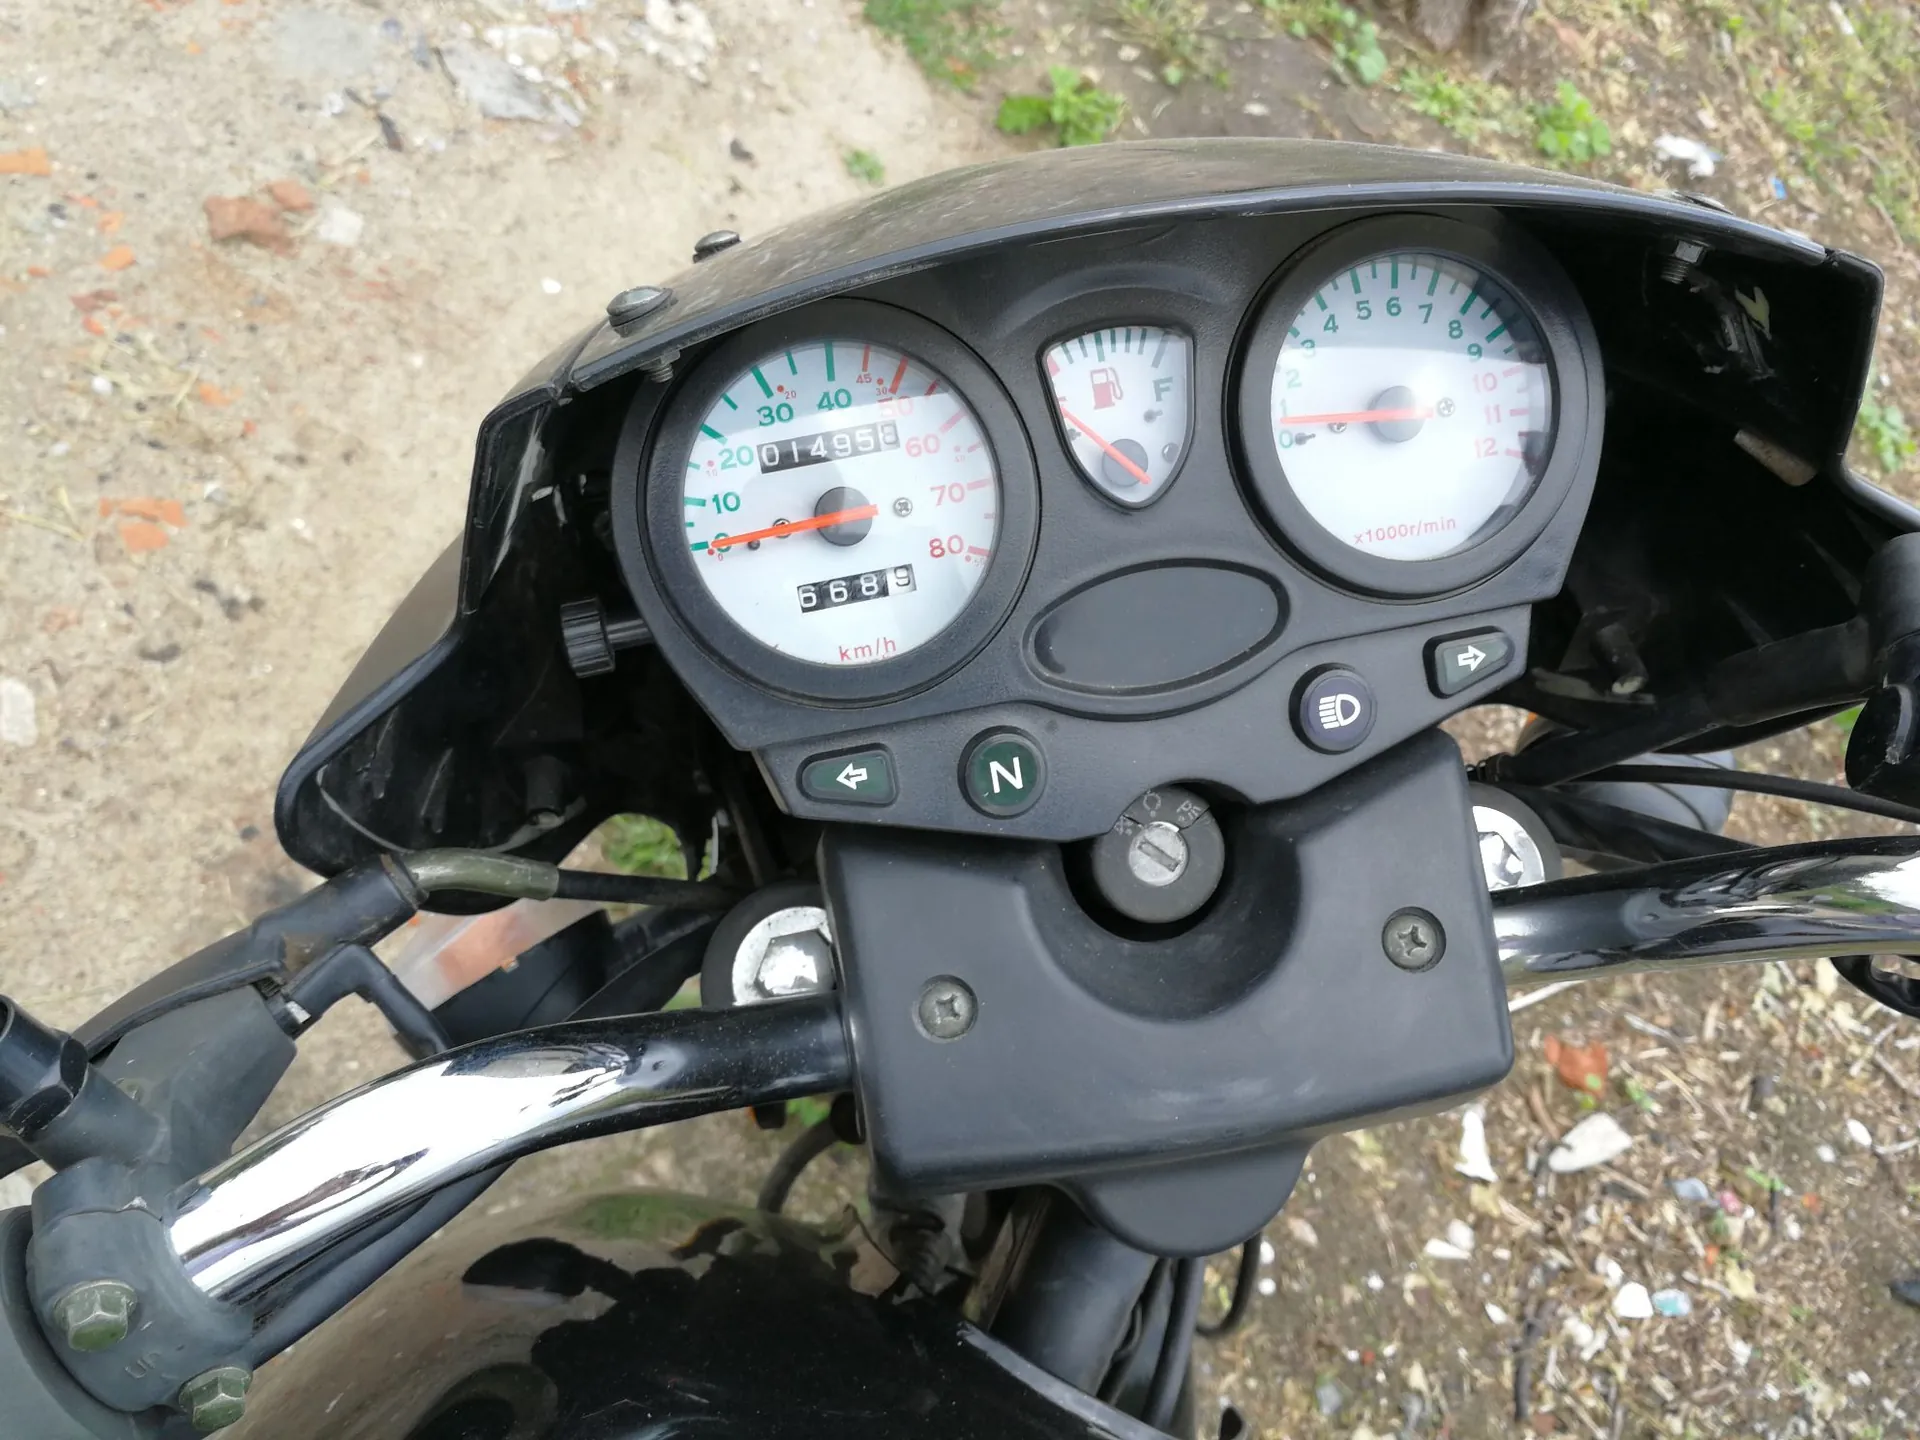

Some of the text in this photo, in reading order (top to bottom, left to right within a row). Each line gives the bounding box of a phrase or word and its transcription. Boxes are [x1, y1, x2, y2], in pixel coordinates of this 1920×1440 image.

[1356, 299, 1373, 321] 5
[1386, 296, 1402, 317] 6
[1418, 303, 1434, 325] 7
[1323, 314, 1339, 334] 4
[1448, 319, 1464, 340] 8
[1300, 339, 1317, 359] 3
[1466, 343, 1484, 362] 9
[855, 374, 873, 384] 45
[1152, 376, 1174, 402] F
[1285, 369, 1303, 389] 2
[1473, 371, 1499, 393] 10
[783, 389, 797, 400] 20
[816, 388, 852, 412] 40
[875, 386, 889, 397] 30
[757, 402, 794, 428] 30
[876, 395, 914, 418] 50
[1484, 404, 1503, 425] 11
[905, 433, 941, 458] 60
[1278, 430, 1295, 450] 0
[1475, 437, 1500, 459] 12
[717, 445, 755, 471] 20
[711, 491, 741, 514] 10
[930, 484, 966, 507] 70
[1353, 515, 1457, 546] x1000r/min
[929, 534, 964, 560] 80
[838, 636, 897, 663] km/h
[989, 756, 1024, 794] N
